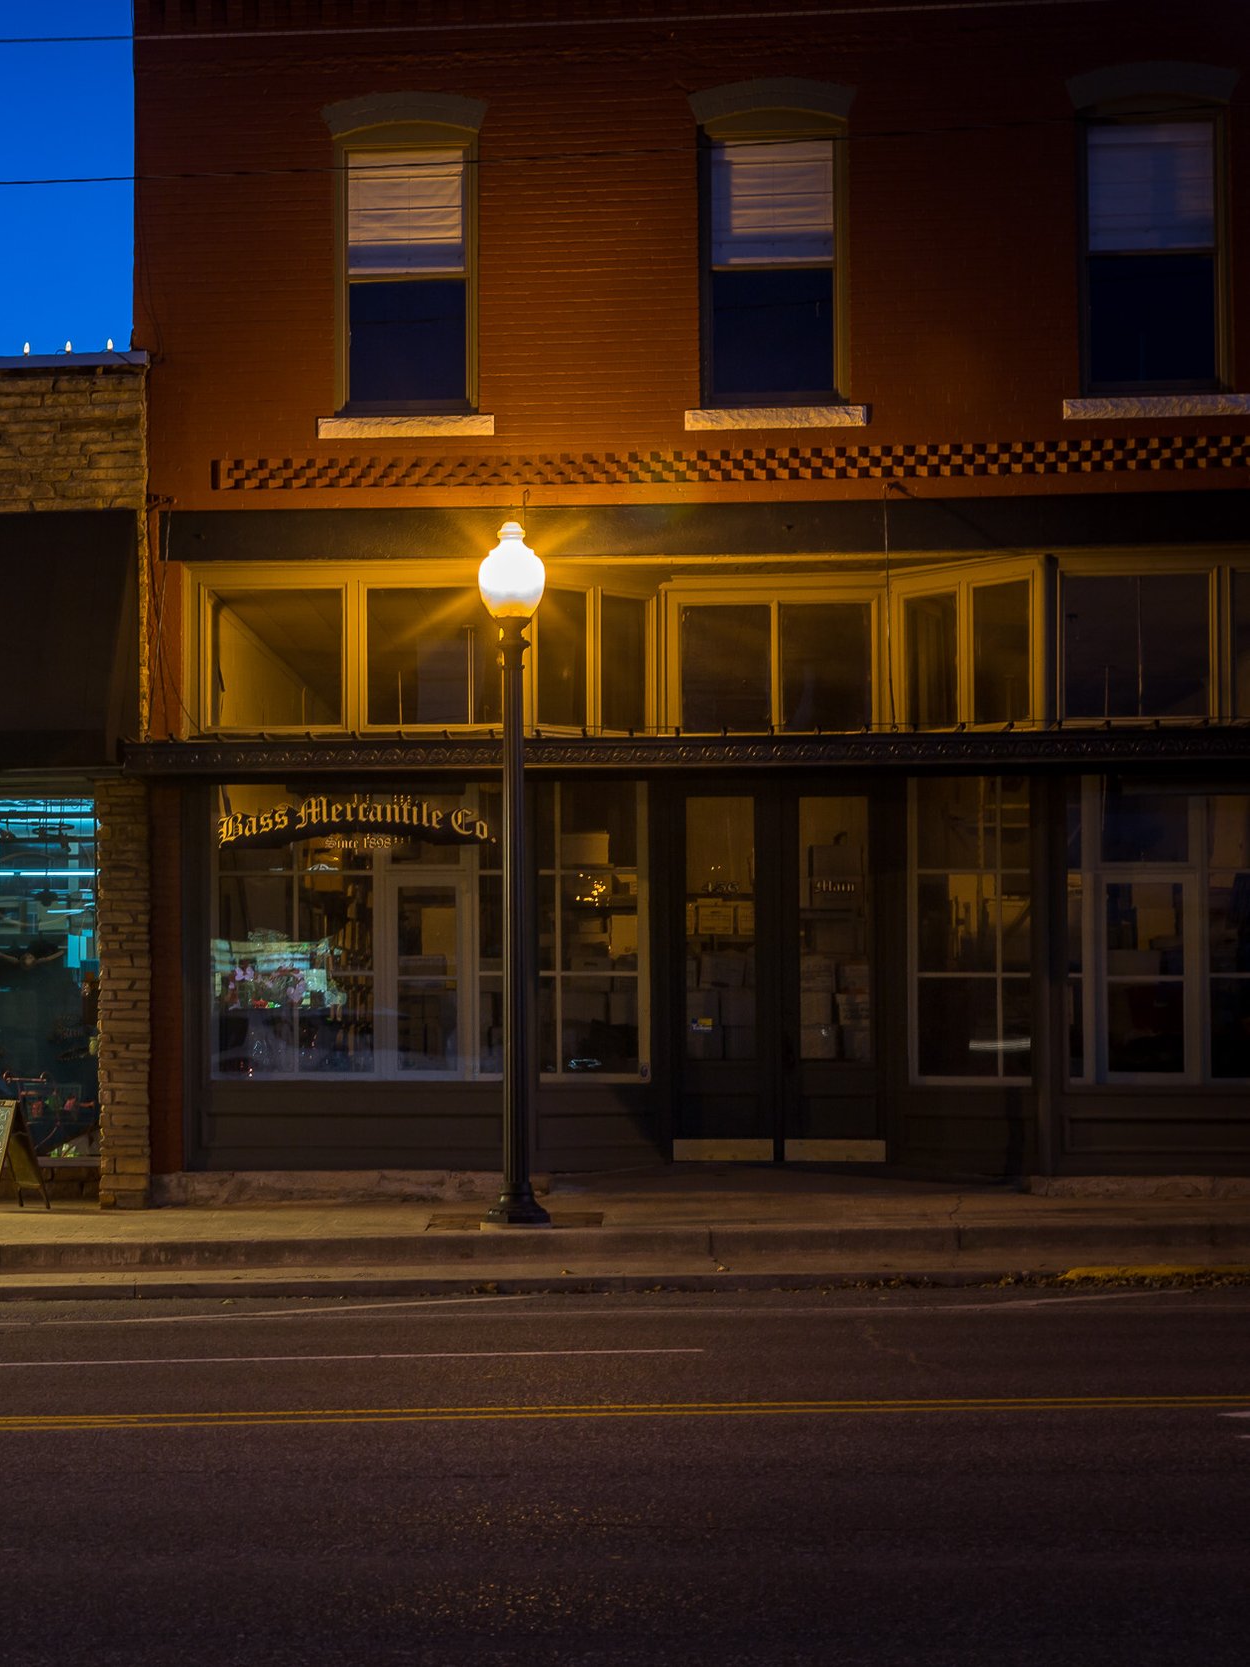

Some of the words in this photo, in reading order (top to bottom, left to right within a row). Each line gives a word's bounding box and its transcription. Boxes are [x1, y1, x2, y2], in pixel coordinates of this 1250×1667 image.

[217, 805, 289, 848] Bass
[295, 794, 443, 830] Mercantile
[450, 808, 497, 843] Co.
[324, 835, 359, 850] Since
[362, 836, 392, 849] 1898
[813, 880, 855, 894] Main
